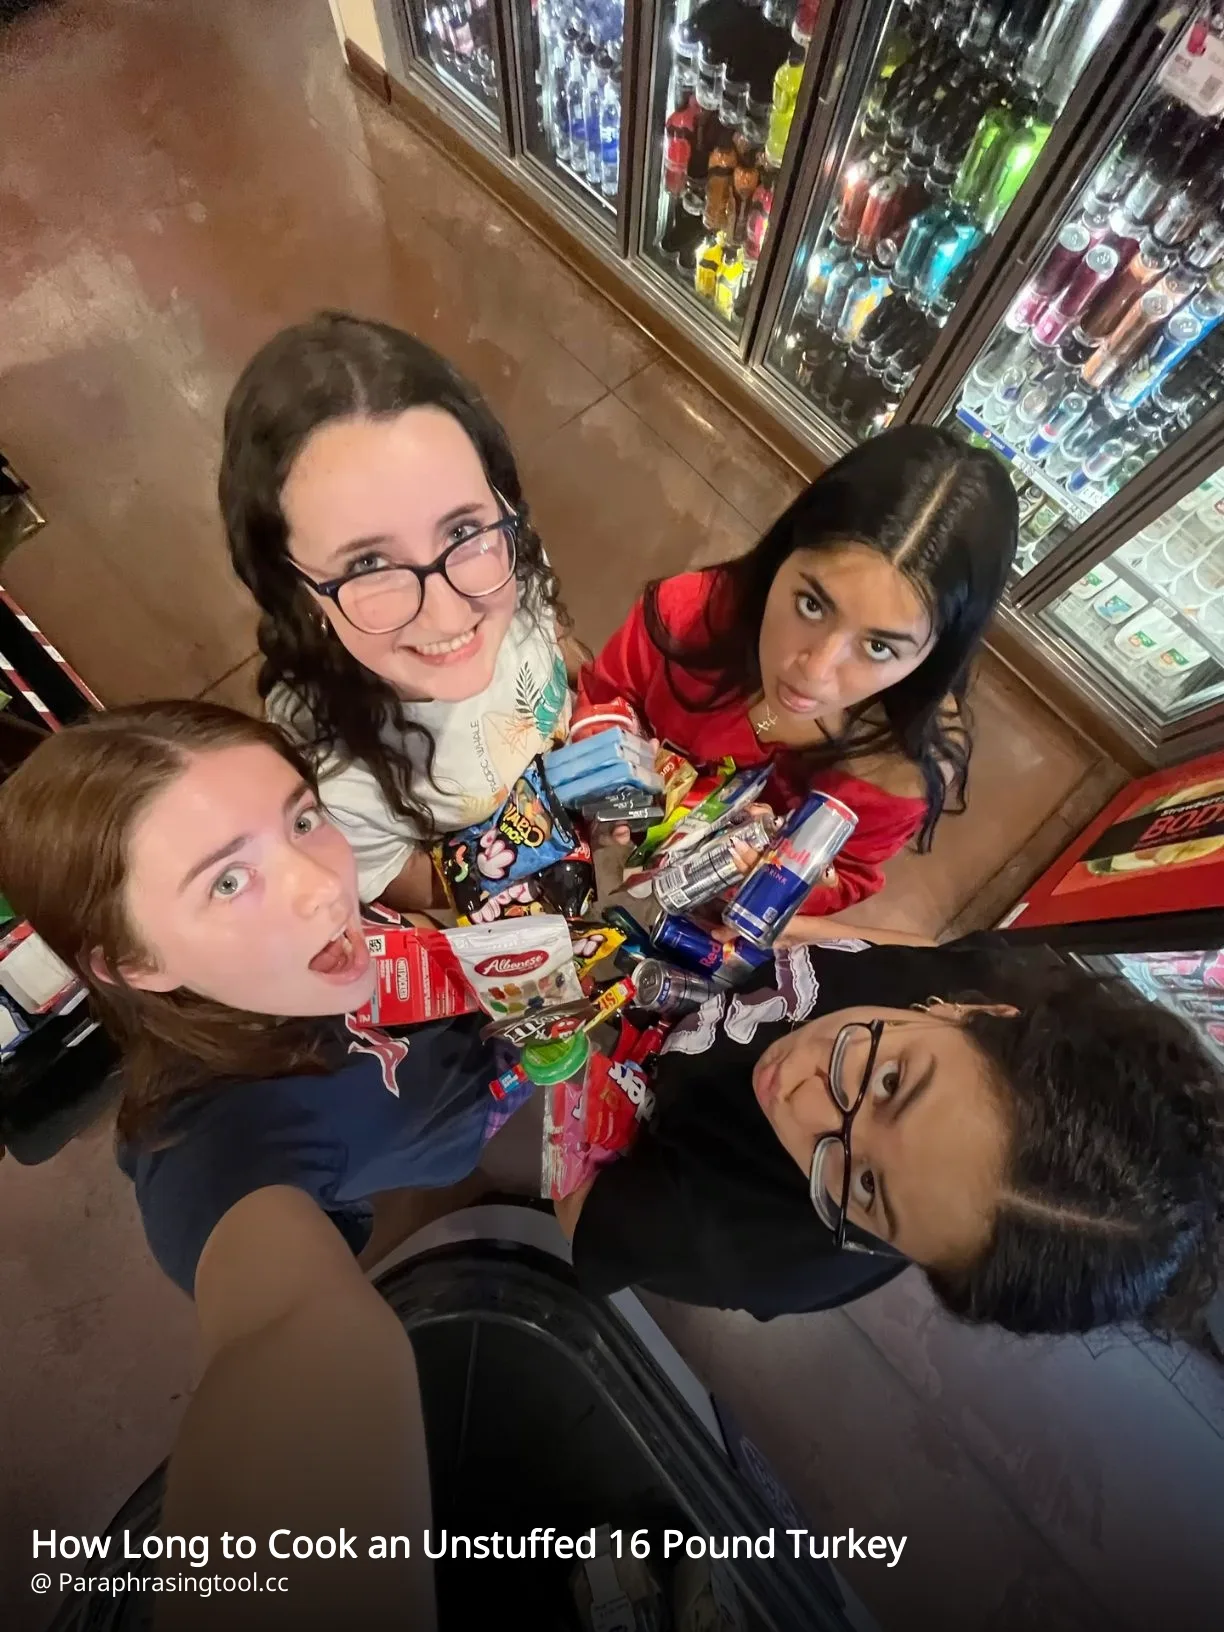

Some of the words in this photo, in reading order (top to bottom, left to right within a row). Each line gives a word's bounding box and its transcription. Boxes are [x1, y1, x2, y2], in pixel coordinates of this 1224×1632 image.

[470, 719, 485, 758] WHALE
[499, 821, 522, 846] SOUR
[700, 939, 722, 968] Red
